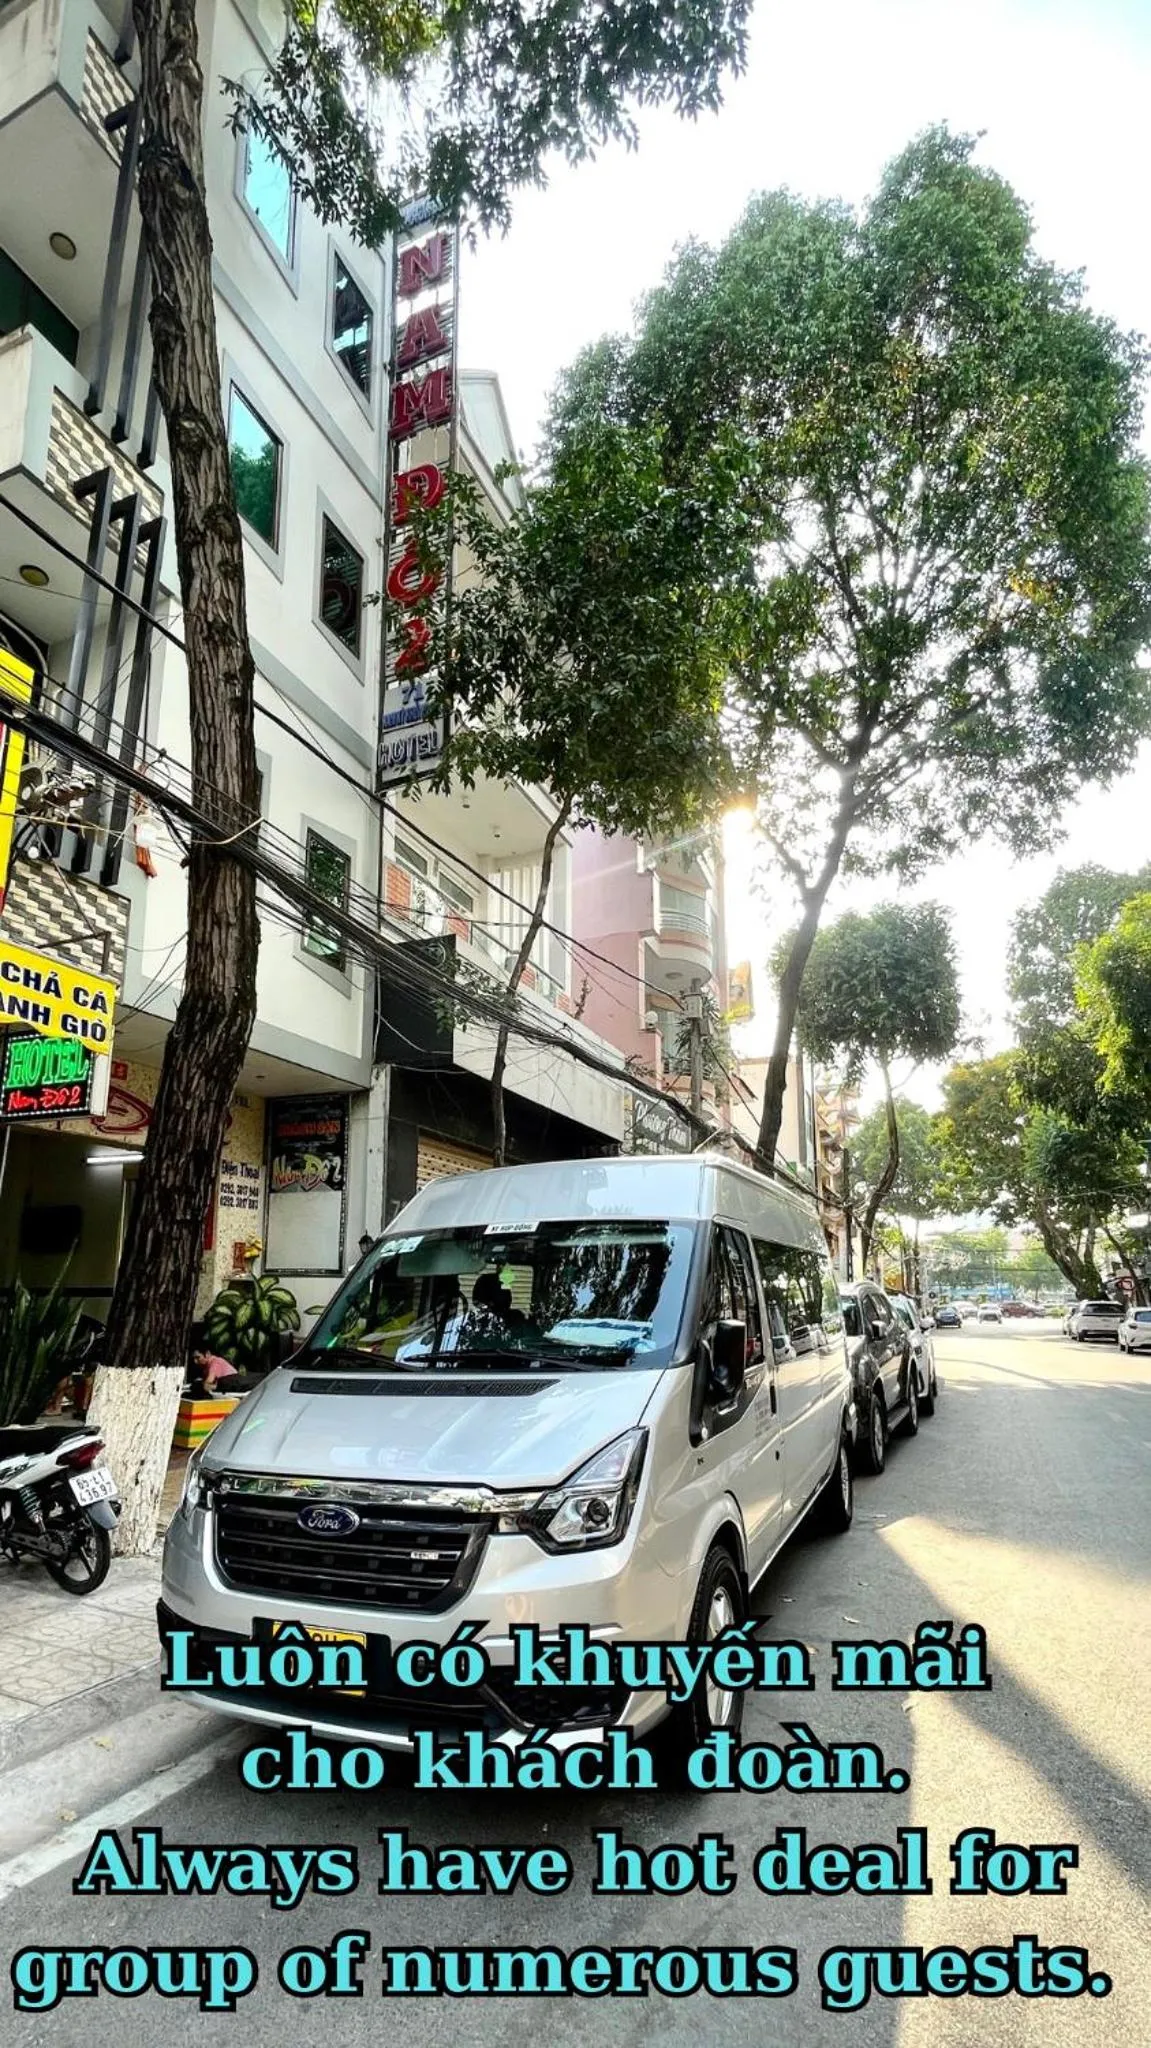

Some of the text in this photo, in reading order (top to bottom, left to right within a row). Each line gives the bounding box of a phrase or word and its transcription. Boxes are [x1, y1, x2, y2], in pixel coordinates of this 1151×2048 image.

[389, 231, 453, 441] NAM
[378, 730, 441, 770] HOTEL
[0, 960, 62, 1000] CHẢ
[61, 1013, 107, 1042] GIÒ
[6, 1036, 90, 1088] HOTEL
[307, 1509, 341, 1530] Ford
